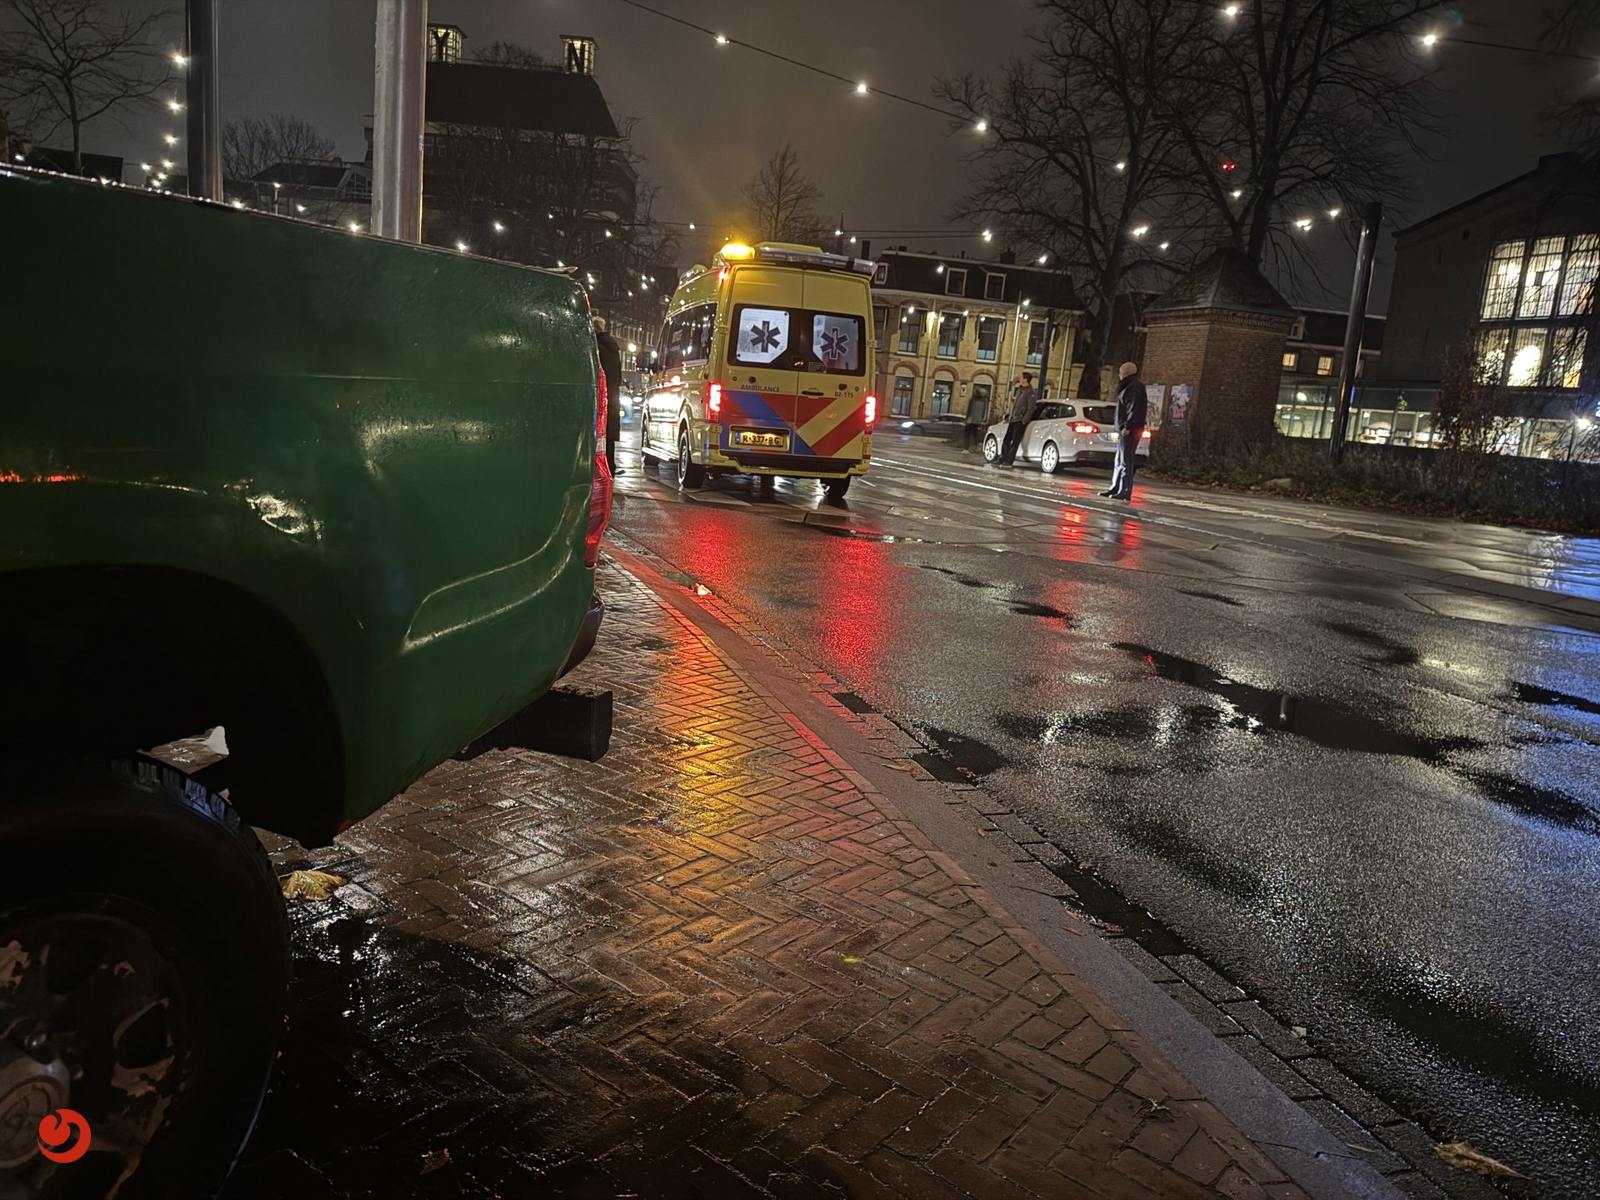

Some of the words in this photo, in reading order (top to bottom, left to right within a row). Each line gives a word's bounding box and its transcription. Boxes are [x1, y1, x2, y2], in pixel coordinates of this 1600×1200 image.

[433, 31, 450, 60] Y
[568, 42, 586, 73] N
[740, 384, 780, 393] AMBULANCE
[834, 391, 854, 399] 02-115
